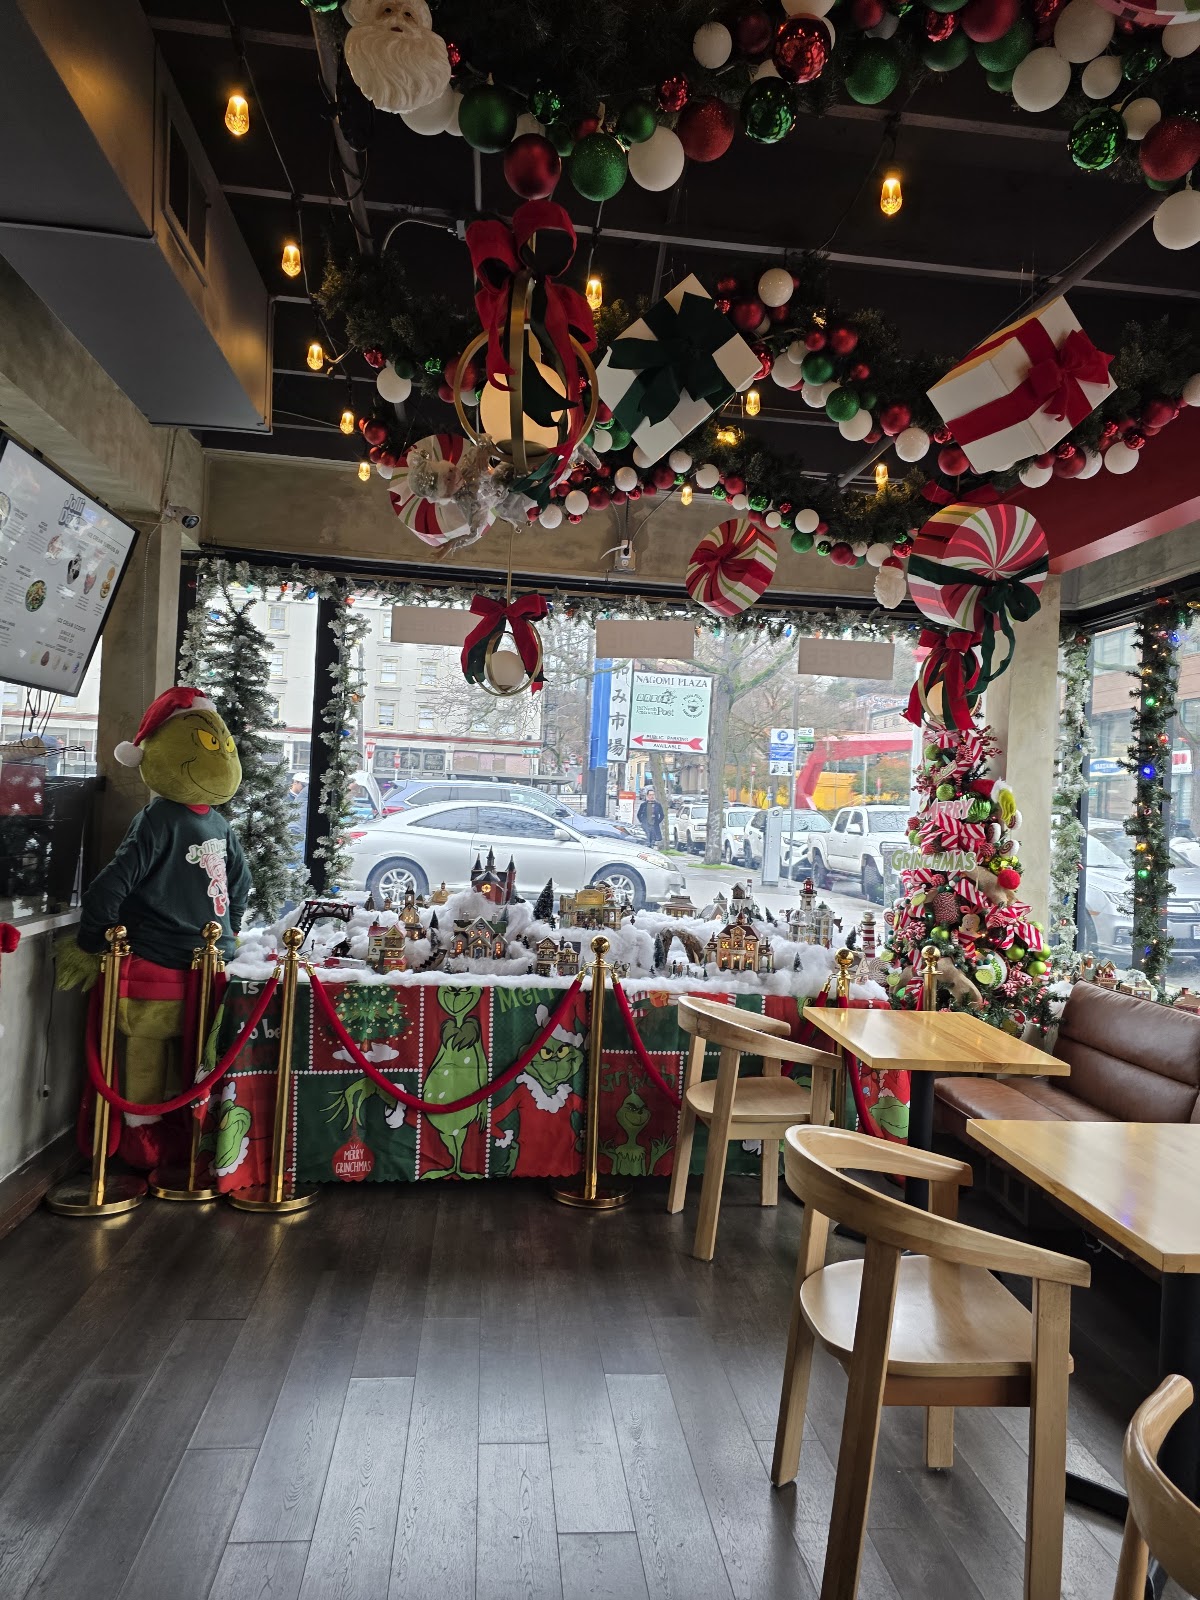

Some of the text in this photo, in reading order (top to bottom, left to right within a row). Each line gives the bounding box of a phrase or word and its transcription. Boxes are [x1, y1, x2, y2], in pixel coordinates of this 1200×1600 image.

[64, 493, 86, 516] Jolli
[635, 674, 708, 688] NAGOMI PLAZA
[656, 706, 675, 717] Post
[919, 797, 974, 820] MERRY
[891, 849, 977, 872] GRINCHMAS
[495, 986, 556, 1013] Mer
[343, 1148, 365, 1161] MERRY
[335, 1160, 372, 1174] GRINCHMAS
